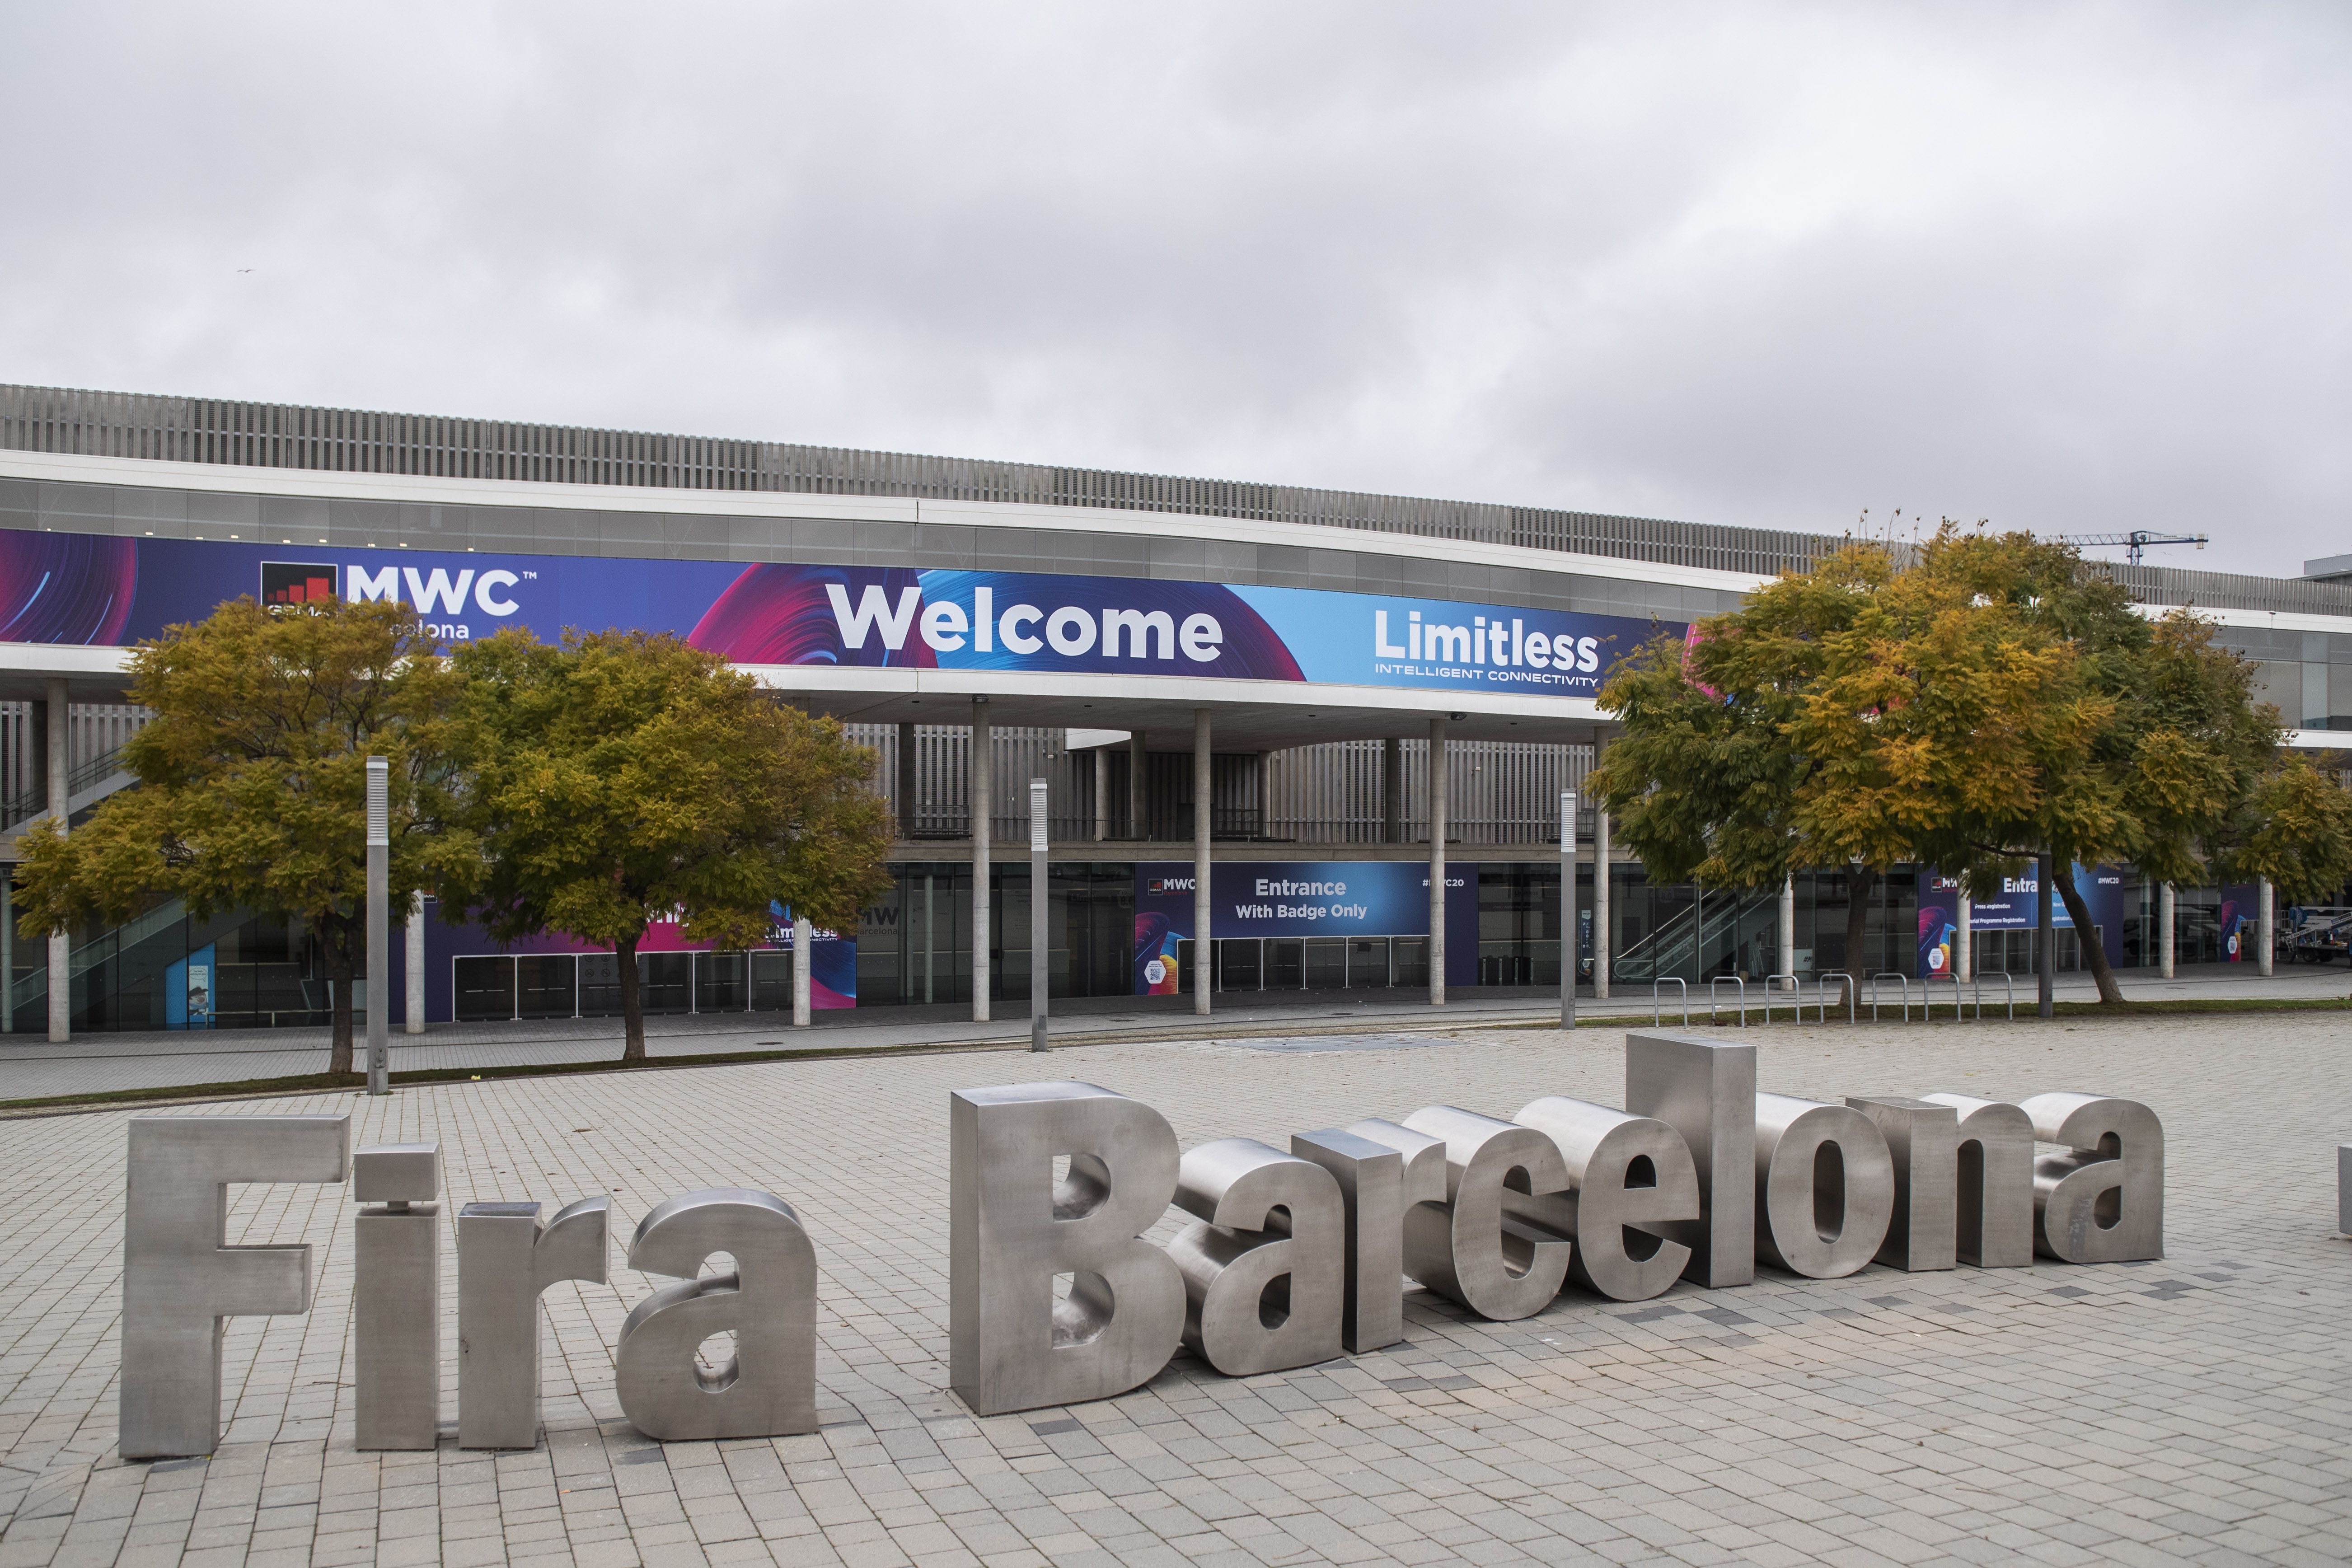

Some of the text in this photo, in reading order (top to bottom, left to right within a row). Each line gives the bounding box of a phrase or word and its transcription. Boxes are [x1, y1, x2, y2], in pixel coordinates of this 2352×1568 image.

[825, 584, 1223, 662] Welcome
[1375, 610, 1598, 672] Limitless
[1375, 663, 1599, 687] INTELLIGENT CONNECTIVITY
[1164, 878, 1195, 890] MWC
[1256, 879, 1346, 896] Entrance
[1422, 879, 1465, 887] #C20
[1236, 903, 1368, 920] With Badge Only
[857, 927, 898, 935] arcelona
[118, 1033, 2164, 1458] Fira Barcelona
